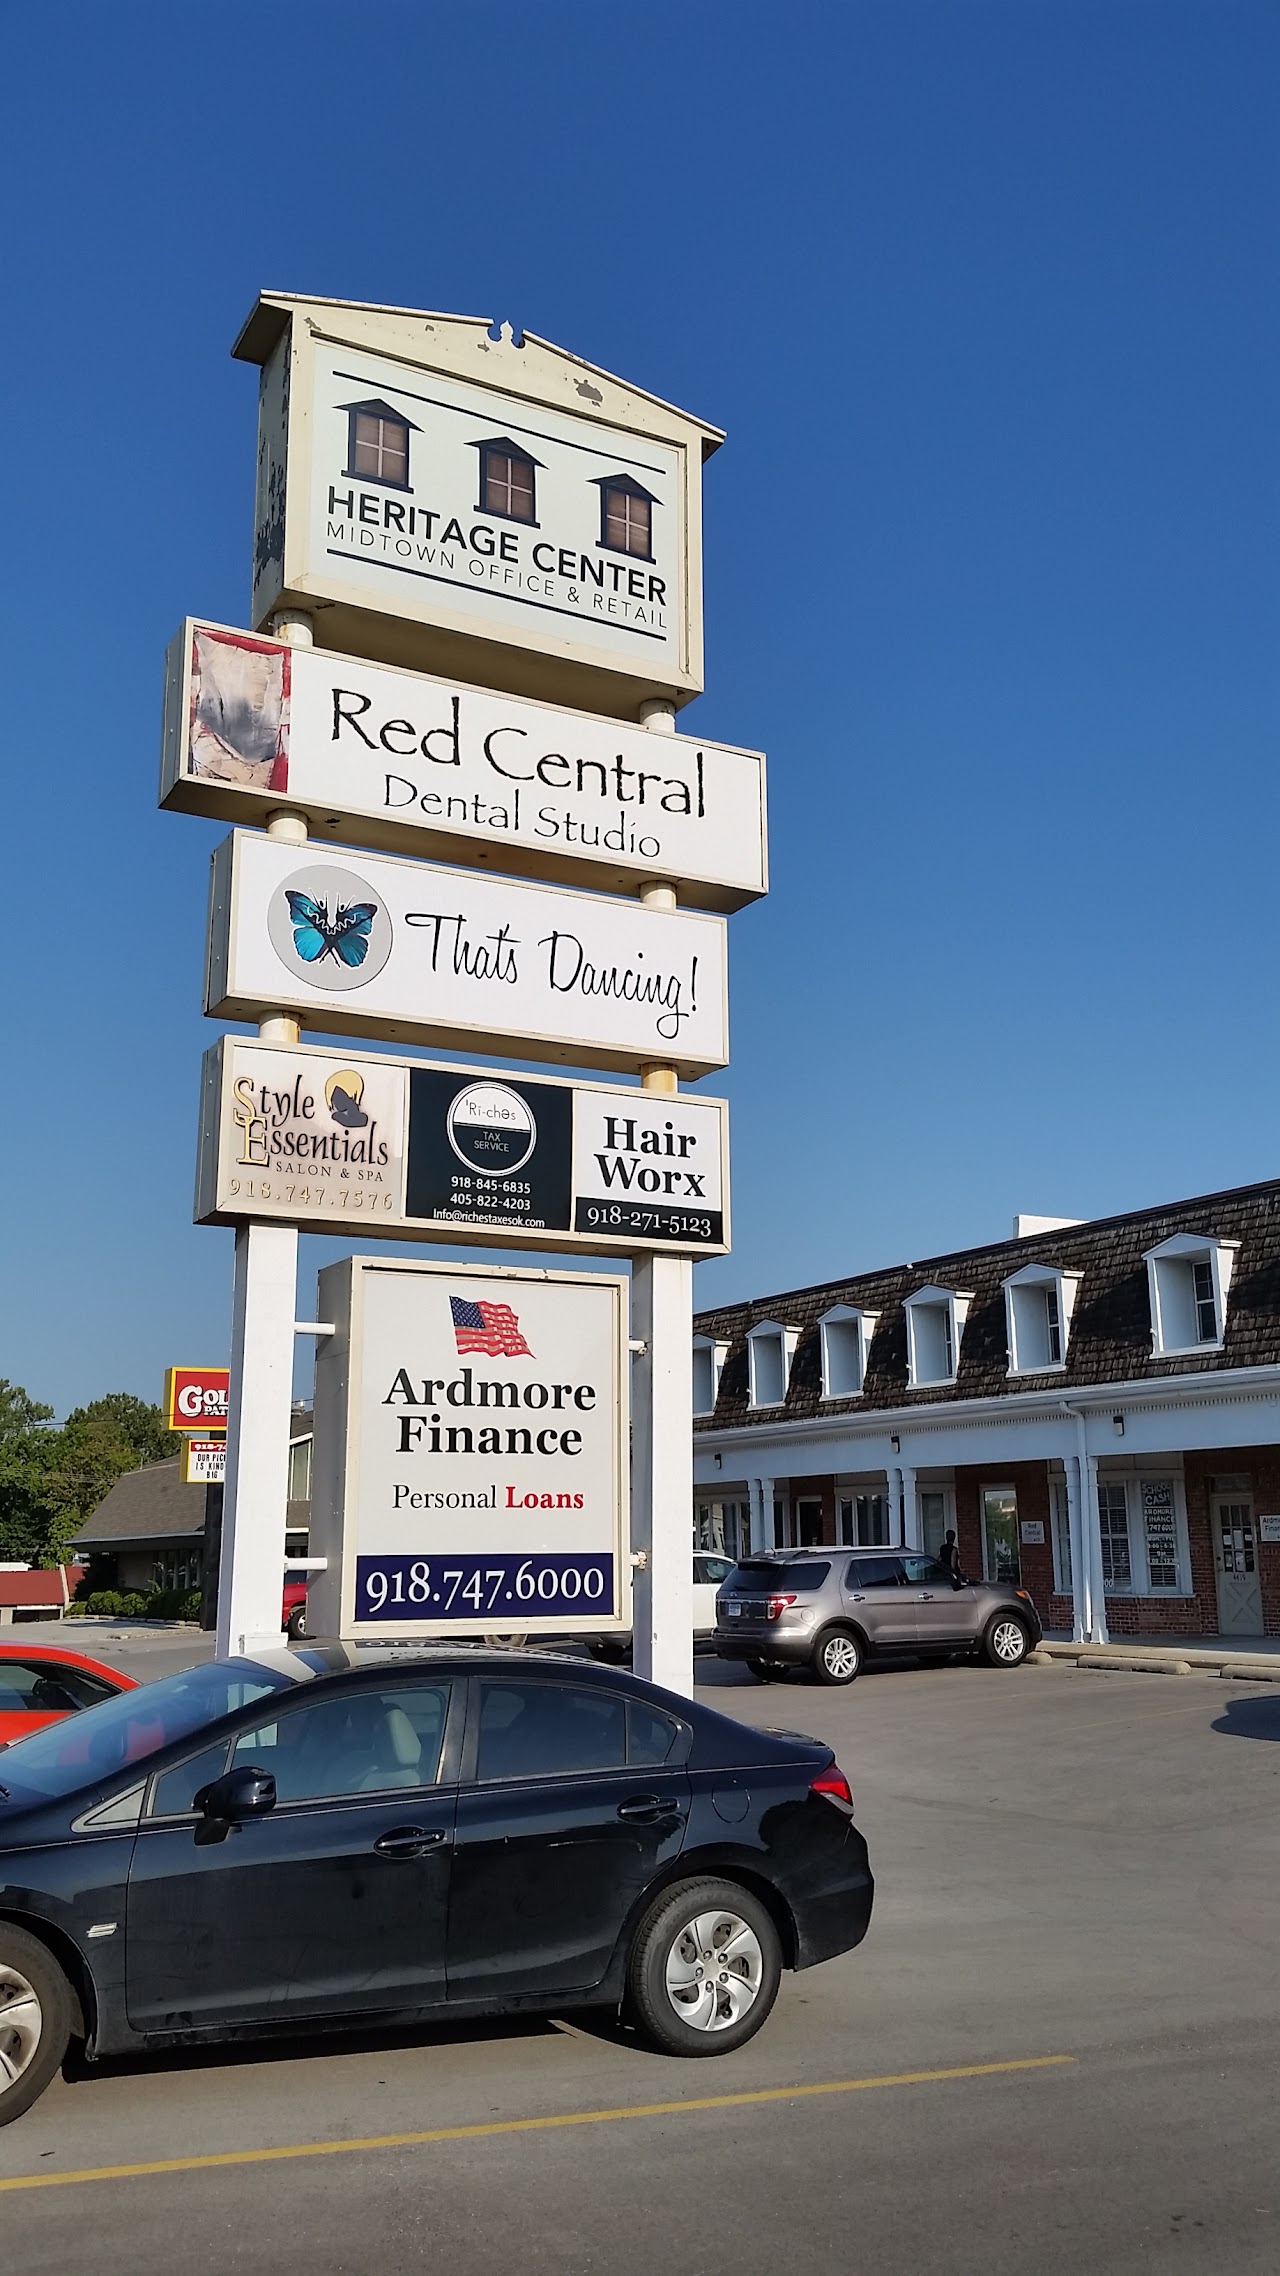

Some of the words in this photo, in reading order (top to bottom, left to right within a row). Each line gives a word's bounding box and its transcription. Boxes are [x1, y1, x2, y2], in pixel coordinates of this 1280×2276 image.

[328, 485, 519, 565] HERITAGE
[532, 542, 667, 607] CENTER
[326, 520, 455, 570] MIDTOWN
[468, 558, 555, 598] OFFICE
[566, 586, 581, 605] &
[592, 592, 668, 630] RETAIL
[331, 687, 462, 766] Red
[483, 727, 706, 818] Central
[384, 774, 521, 832] Dental
[533, 809, 662, 859] Studio
[537, 930, 699, 1040] Dancing!
[233, 1074, 316, 1128] Style
[234, 1114, 389, 1168] Essentials
[473, 1140, 510, 1152] SERVICE
[482, 1131, 501, 1143] TAX
[602, 1116, 697, 1159] Hair
[275, 1161, 332, 1178] SALON
[340, 1167, 350, 1179] &
[357, 1169, 384, 1183] SPA
[450, 1175, 531, 1194] 918-845-6835
[593, 1153, 707, 1198] Worx
[229, 1178, 393, 1211] 918.747.7576
[449, 1192, 531, 1211] 405-822-4203
[433, 1207, 546, 1229] Info@richestaxesok.com
[587, 1205, 712, 1238] 918-271-5123
[381, 1368, 597, 1411] Ardmore
[395, 1414, 583, 1456] Finance
[195, 1462, 204, 1470] IS
[197, 1453, 210, 1462] OUR
[206, 1471, 218, 1479] BIG
[392, 1484, 497, 1509] Personal
[505, 1486, 584, 1510] Loans
[1145, 1492, 1170, 1505] CASH
[365, 1560, 605, 1613] 918.747.6000
